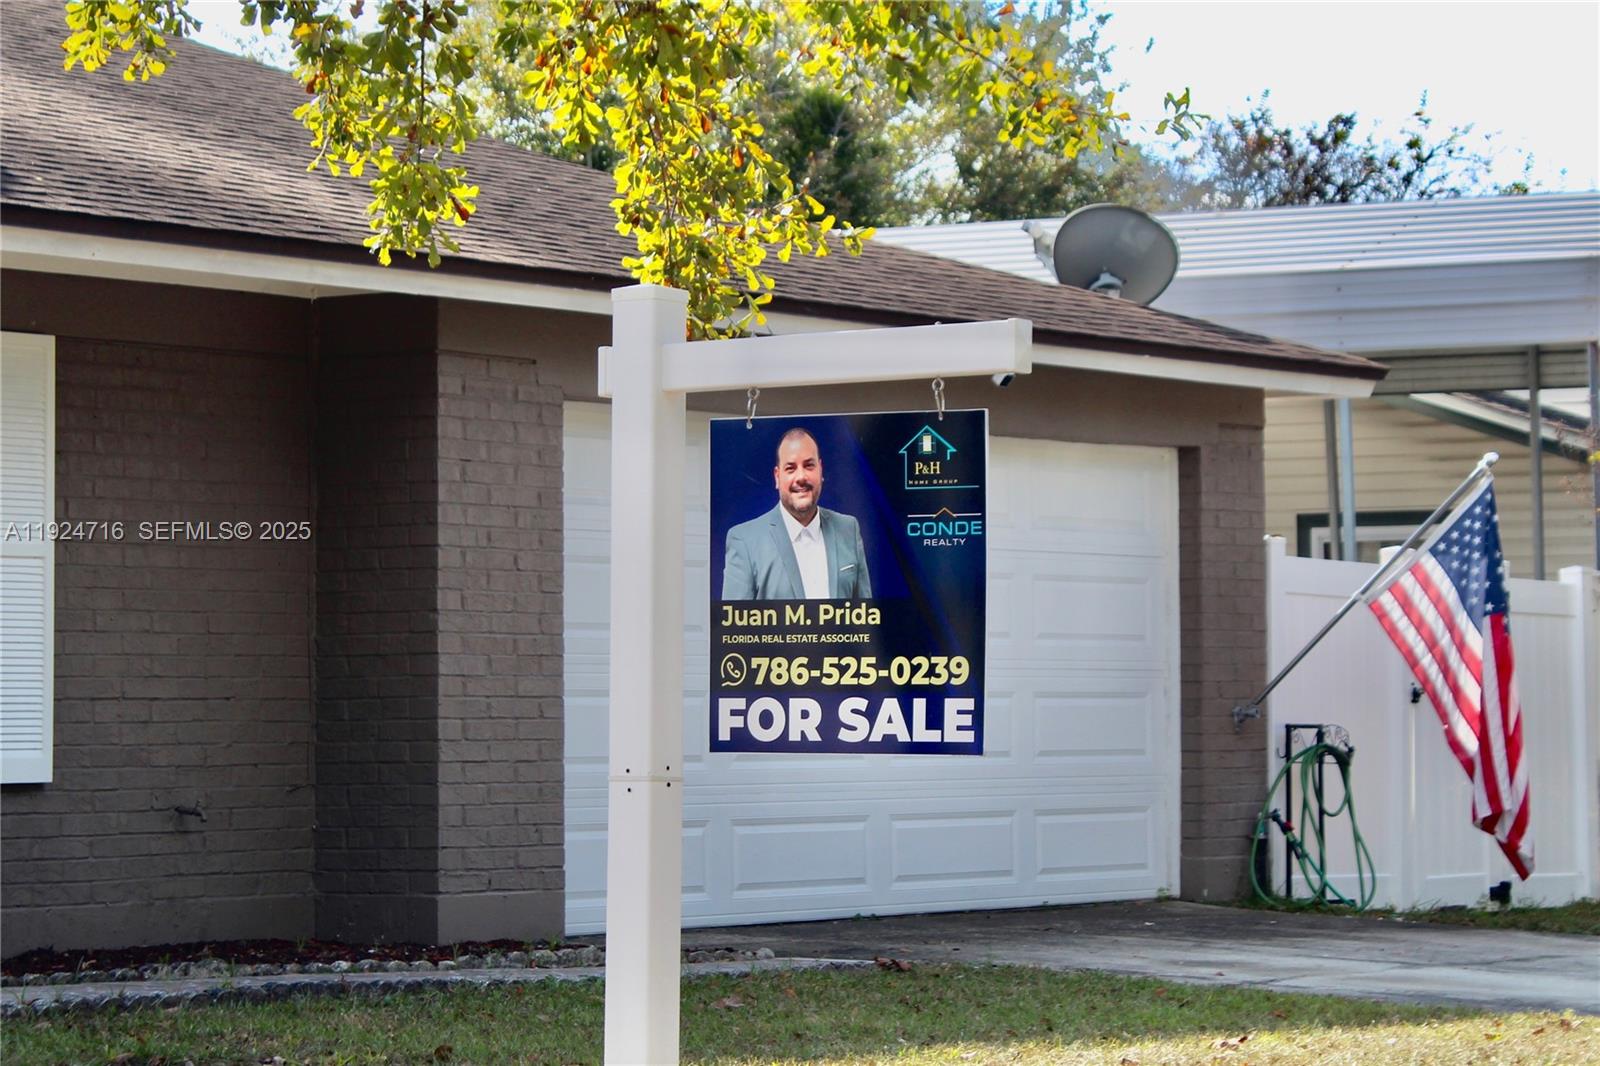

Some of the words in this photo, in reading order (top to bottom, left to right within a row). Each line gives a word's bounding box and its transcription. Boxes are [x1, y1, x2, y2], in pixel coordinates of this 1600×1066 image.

[915, 461, 941, 475] P&H
[907, 520, 983, 537] CONDE
[923, 538, 967, 547] REALTY
[721, 605, 777, 627] Juan
[785, 604, 811, 626] M.
[819, 602, 881, 625] Prida
[722, 634, 760, 644] FLORIDA
[761, 634, 784, 644] REAL
[786, 633, 818, 643] ESTATE
[820, 633, 870, 643] ASSOCIATE
[751, 655, 970, 686] 786-525-0239
[717, 696, 822, 742] FOR
[837, 696, 975, 743] SALE
